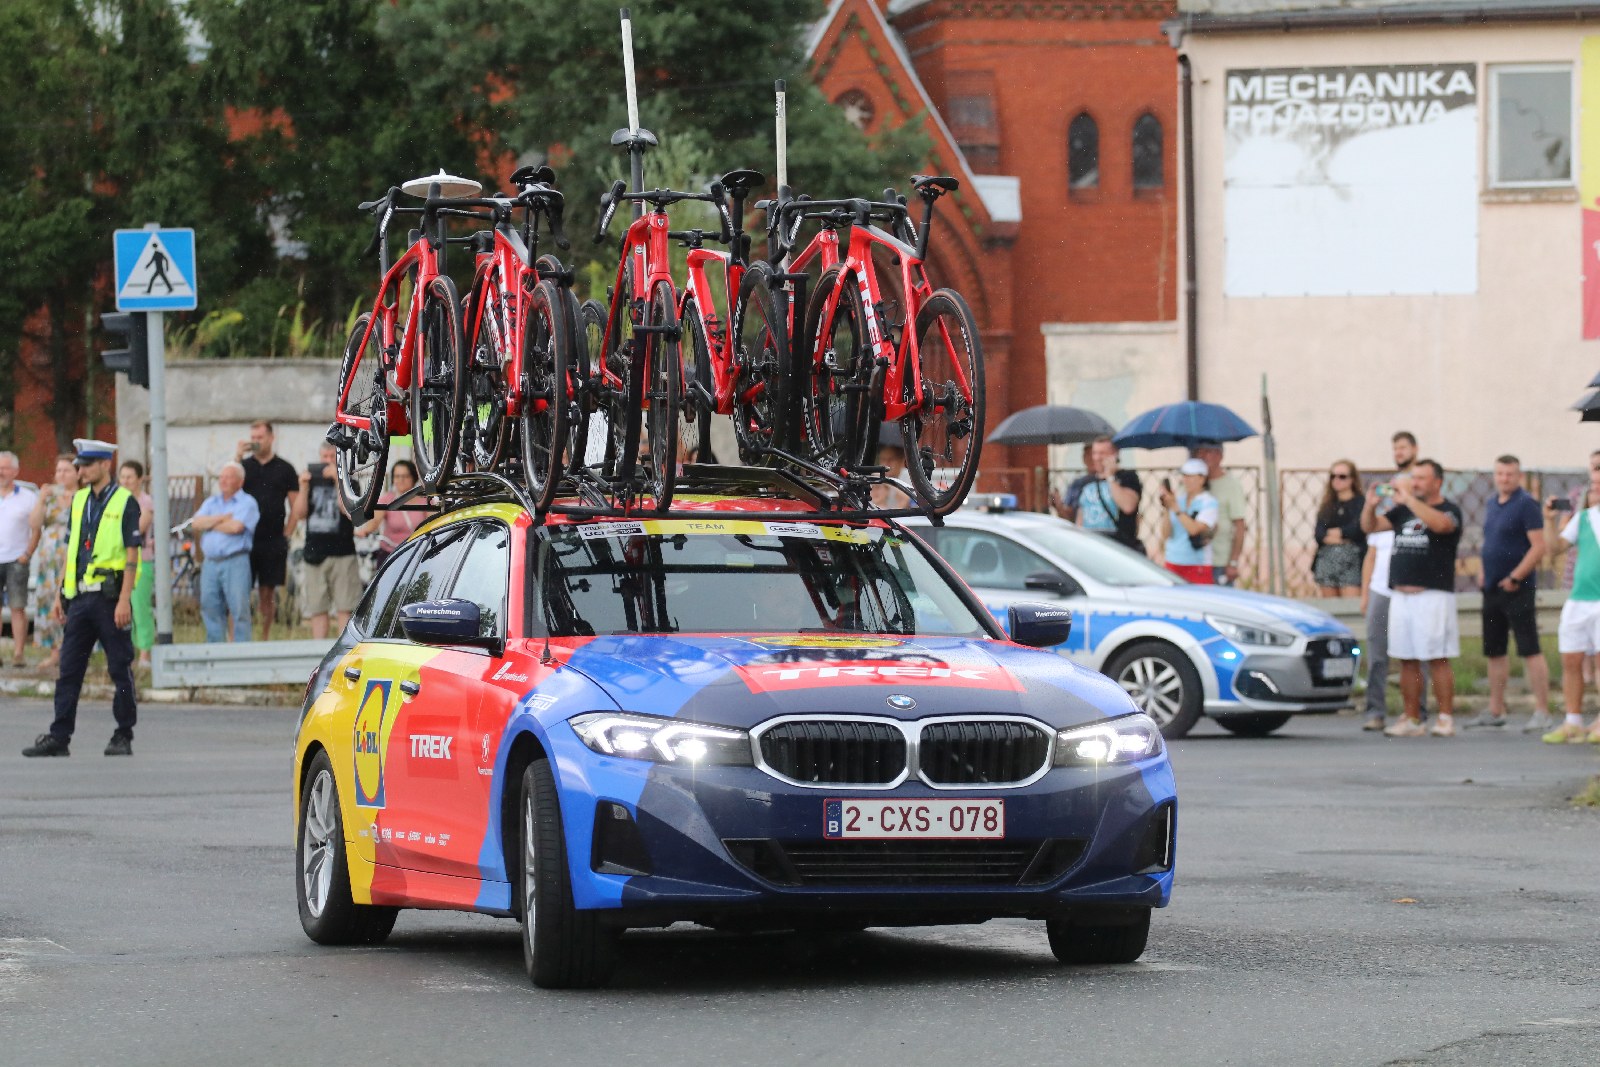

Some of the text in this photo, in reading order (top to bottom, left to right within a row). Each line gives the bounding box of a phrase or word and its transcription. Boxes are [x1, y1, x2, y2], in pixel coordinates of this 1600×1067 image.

[1227, 70, 1475, 101] MECHANIKA
[686, 522, 725, 531] TEAM
[762, 666, 989, 681] TREK
[409, 734, 453, 760] TREK
[828, 820, 839, 833] B
[845, 805, 999, 832] 2-CXS-078
